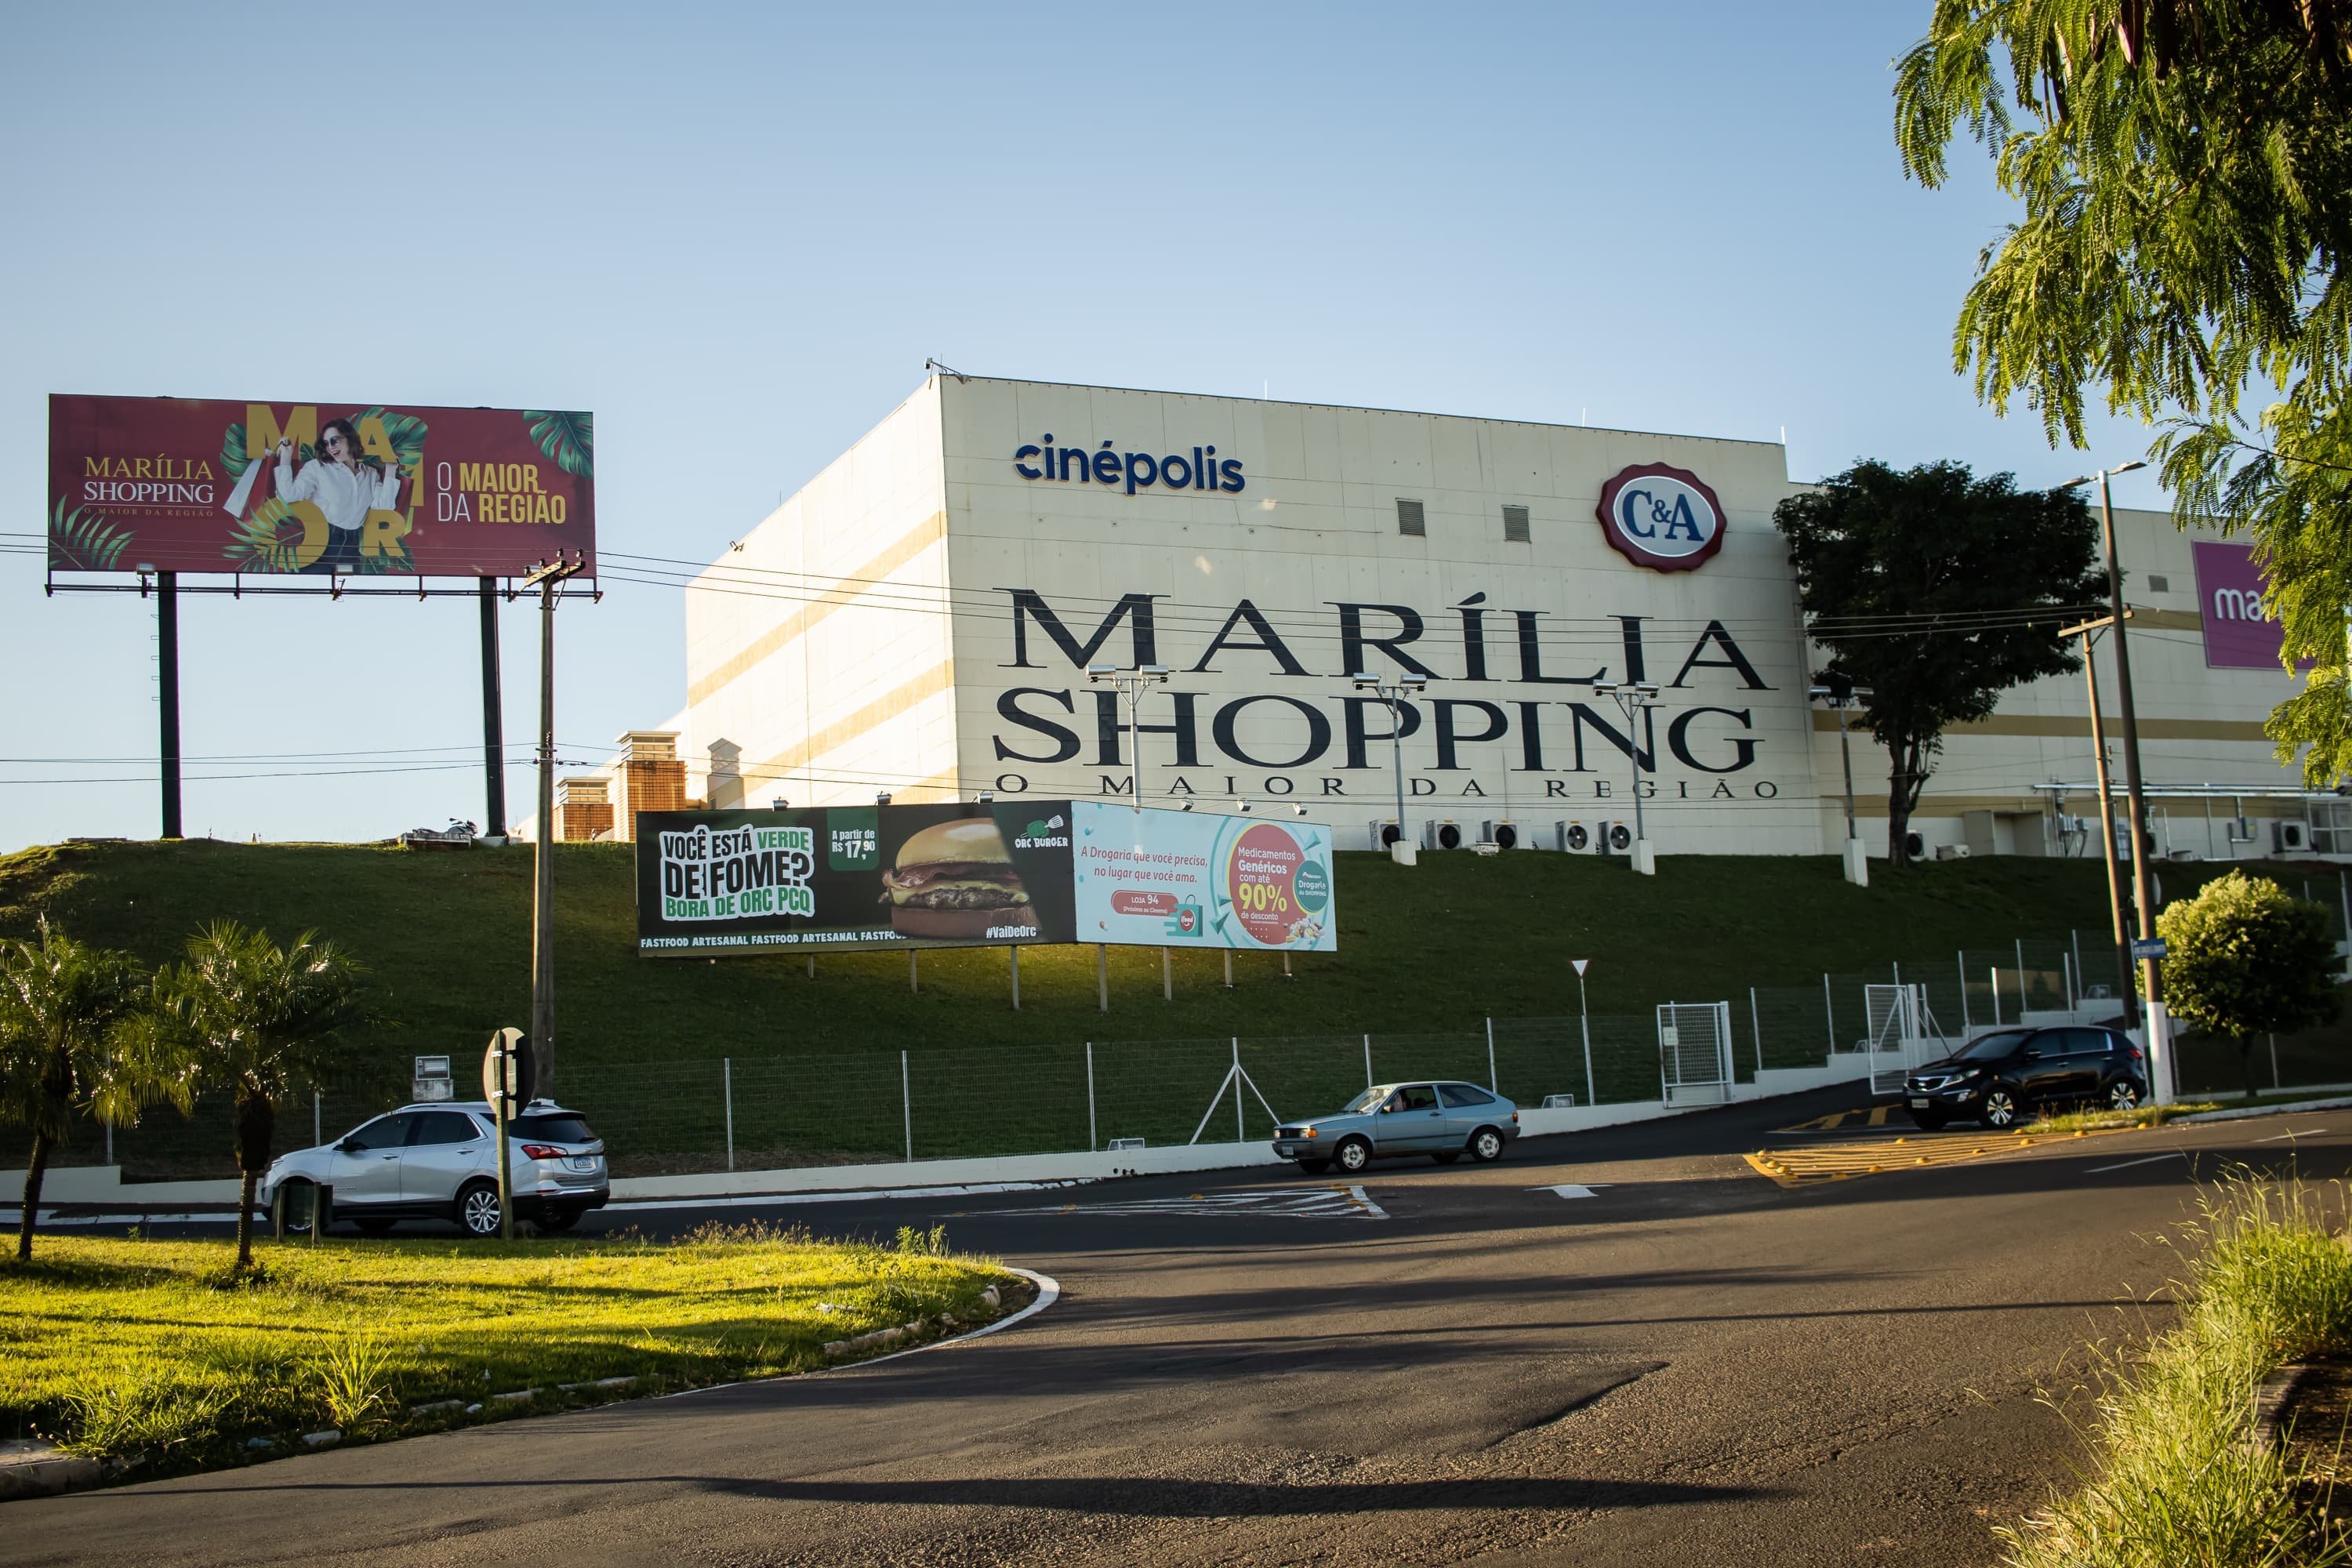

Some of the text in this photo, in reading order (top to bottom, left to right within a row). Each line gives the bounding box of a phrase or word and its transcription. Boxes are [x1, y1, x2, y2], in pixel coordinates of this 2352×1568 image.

[84, 452, 215, 481] MARÍLIA
[1014, 433, 1246, 495] cinépolis
[437, 462, 539, 493] O MAIOR
[84, 481, 214, 503] SHOPPING
[167, 508, 213, 517] REGIÃO
[437, 489, 566, 524] DA REGIÃO
[1622, 490, 1704, 542] C&A
[993, 587, 1780, 691] MARÍLIA
[993, 688, 1766, 774] SHOPPING
[996, 774, 1778, 800] O MAIOR DA REGIÃO
[664, 828, 810, 861] VOCÊ ESTÁ VERDE
[832, 829, 875, 841] A partir de
[1014, 837, 1069, 848] ORC BURGER
[832, 842, 844, 852] R$
[1081, 846, 1208, 868] A Drogaria que você precisa,
[1238, 847, 1296, 861] Medicamentos
[710, 851, 811, 898] FOME?
[1094, 866, 1197, 883] no lugar que você ama.
[1238, 859, 1287, 874] Genéricos
[1239, 873, 1270, 883] com até
[1298, 880, 1326, 890] Drogaria
[666, 887, 811, 918] BORA DE ORC PCQ
[1147, 894, 1159, 905] 94
[1239, 883, 1287, 912] 90%
[1241, 911, 1279, 920] de desconto
[641, 931, 907, 948] FASTFOOD ARTESANAL FASTFOOD ARTESANAL FASTFO
[986, 925, 1036, 939] #VaiDeOrc
